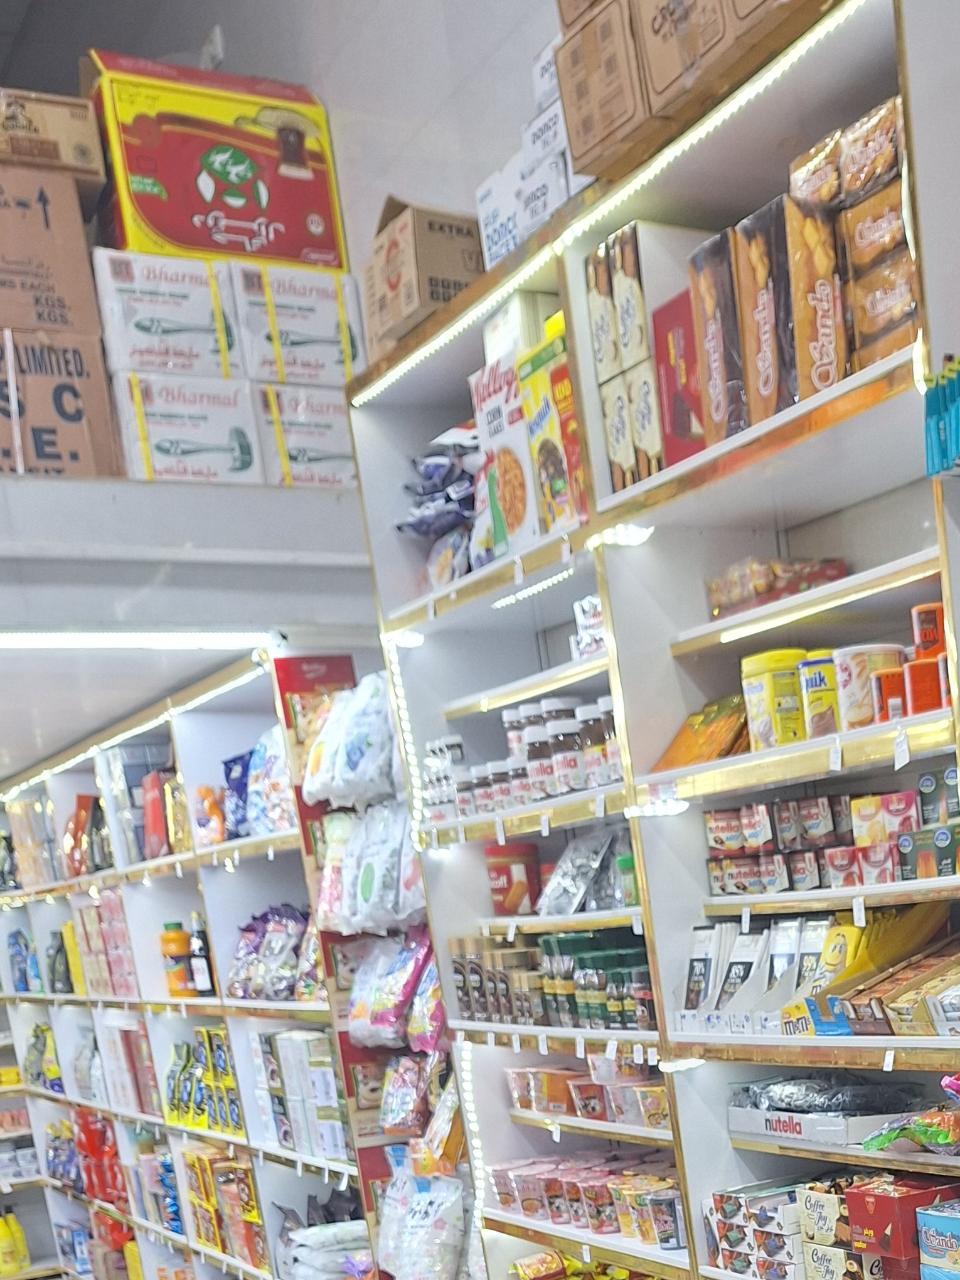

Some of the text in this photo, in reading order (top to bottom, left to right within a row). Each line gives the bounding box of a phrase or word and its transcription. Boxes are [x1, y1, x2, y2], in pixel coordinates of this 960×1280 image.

[428, 220, 475, 239] EXTRA
[15, 345, 90, 380] LIMITED.
[52, 382, 85, 424] C
[157, 384, 242, 408] Bharmal
[764, 1114, 803, 1136] nutella
[804, 1193, 826, 1213] Coffee
[811, 1246, 833, 1266] Coffee
